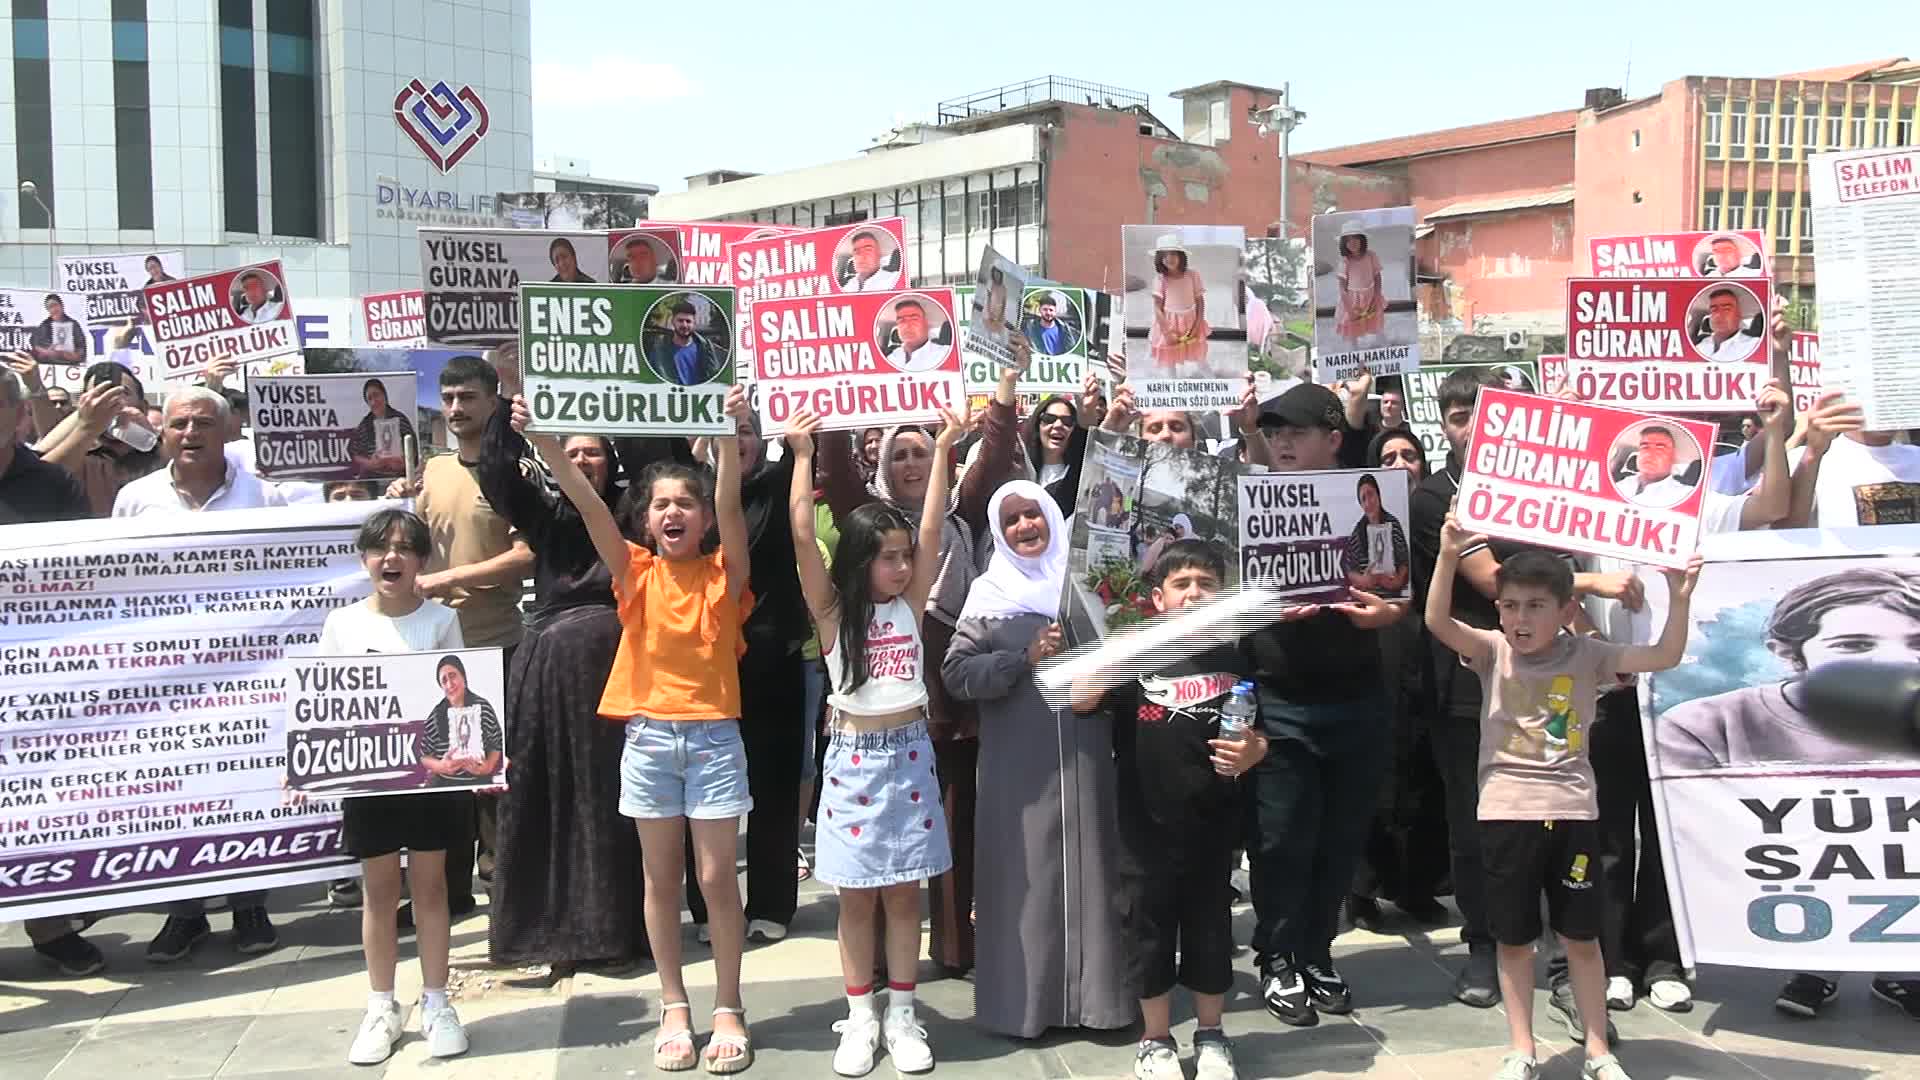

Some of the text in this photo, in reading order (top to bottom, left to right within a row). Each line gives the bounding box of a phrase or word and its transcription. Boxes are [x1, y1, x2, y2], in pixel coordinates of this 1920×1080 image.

[1843, 178, 1910, 198] TELEFON
[426, 237, 508, 264] YÜKSEL
[681, 227, 721, 257] LİM
[1596, 237, 1676, 268] SALİM
[65, 261, 118, 276] YÜKSEL
[429, 263, 520, 289] GÜRAN'A
[684, 262, 729, 284] AN'A
[737, 240, 816, 281] SALİM
[67, 277, 129, 291] GÜRAN'A
[88, 294, 140, 317] GÜRLÜK
[152, 283, 217, 317] SALİM
[368, 295, 424, 321] SALİM
[430, 296, 520, 331] ÖZGÜRLÜ
[1576, 285, 1667, 323] SALİM
[158, 307, 234, 341] GÜRAN'A
[371, 318, 426, 341] GÜRAN'
[529, 296, 612, 336] ENES
[760, 300, 855, 344] SALİM
[165, 327, 289, 370] ÖZGÜRLÜK!
[531, 337, 640, 375] GÜRAN'A
[1575, 324, 1684, 358] GÜRAN'A
[763, 341, 876, 378] GÜRAN'A
[1325, 347, 1409, 367] NARİN HAKİKAT
[1384, 362, 1402, 374] VAR
[255, 382, 326, 404] YÜKSEL
[768, 376, 953, 422] ÖZGÜRLÜK!
[1576, 366, 1757, 401] ÖZGÜRLÜK!
[258, 405, 339, 427] GÜRAN'A
[533, 384, 725, 423] ÖZGÜRLÜK!
[1484, 402, 1593, 451] SALİM
[259, 434, 352, 467] ÖZGÜRLÜK
[1476, 441, 1601, 494] GÜRAN'A
[1244, 480, 1320, 508] YÜKSEL
[1247, 510, 1332, 538] GÜRAN'A
[1467, 482, 1681, 556] ÖZGÜRLÜK!
[40, 567, 127, 581] TELEFON
[135, 562, 226, 576] İMAJLARI
[233, 557, 328, 571] SİLİNEREK
[173, 549, 256, 563] KAMERA
[264, 544, 355, 559] KAYITLARI
[1246, 543, 1345, 585] ÖZGÜRLÜK
[12, 581, 95, 594] OLMAZ!
[195, 586, 333, 603] ENGELLENMEZ!
[17, 610, 113, 625] İMAJLARI
[205, 600, 285, 614] KAMERA
[291, 597, 367, 610] KAYITLA
[48, 643, 126, 658] ADALET
[133, 639, 201, 653] SOMUT
[209, 634, 278, 650] DELİLER
[106, 653, 185, 669] TEKRAR
[192, 648, 284, 665] YAPILSIN!
[296, 662, 387, 692] YÜKSEL
[16, 705, 77, 722] KATİL
[83, 700, 162, 718] ORTAYA
[169, 691, 287, 713] ÇIKARILSIN!
[27, 689, 101, 706] YANLIŞ
[108, 683, 207, 701] DELİLERLE
[296, 693, 402, 722] GÜRAN'A
[12, 729, 128, 751] İSTİYORUZ!
[136, 723, 211, 740] GERÇEK
[218, 716, 271, 733] KATİL
[16, 749, 57, 764] YOK
[64, 743, 142, 760] DELİLER
[148, 739, 185, 752] YOK
[192, 732, 266, 749] SAYILDI!
[293, 727, 417, 776] ÖZGÜRLÜK
[51, 770, 128, 789] GERÇEK
[135, 762, 210, 781] ADALET!
[216, 755, 286, 773] DELİLER
[56, 779, 184, 802] YENİLENSİN!
[38, 811, 90, 830] ÜSTÜ
[97, 799, 233, 824] ÖRTÜLENMEZ!
[1738, 789, 1920, 834] YÜK
[15, 826, 111, 847] KAYITLARI
[193, 809, 265, 828] KAMERA
[91, 846, 180, 881] İÇİN
[190, 826, 344, 867] ADALET!
[1744, 844, 1920, 881] SAL
[1747, 884, 1920, 943] ÖZ
